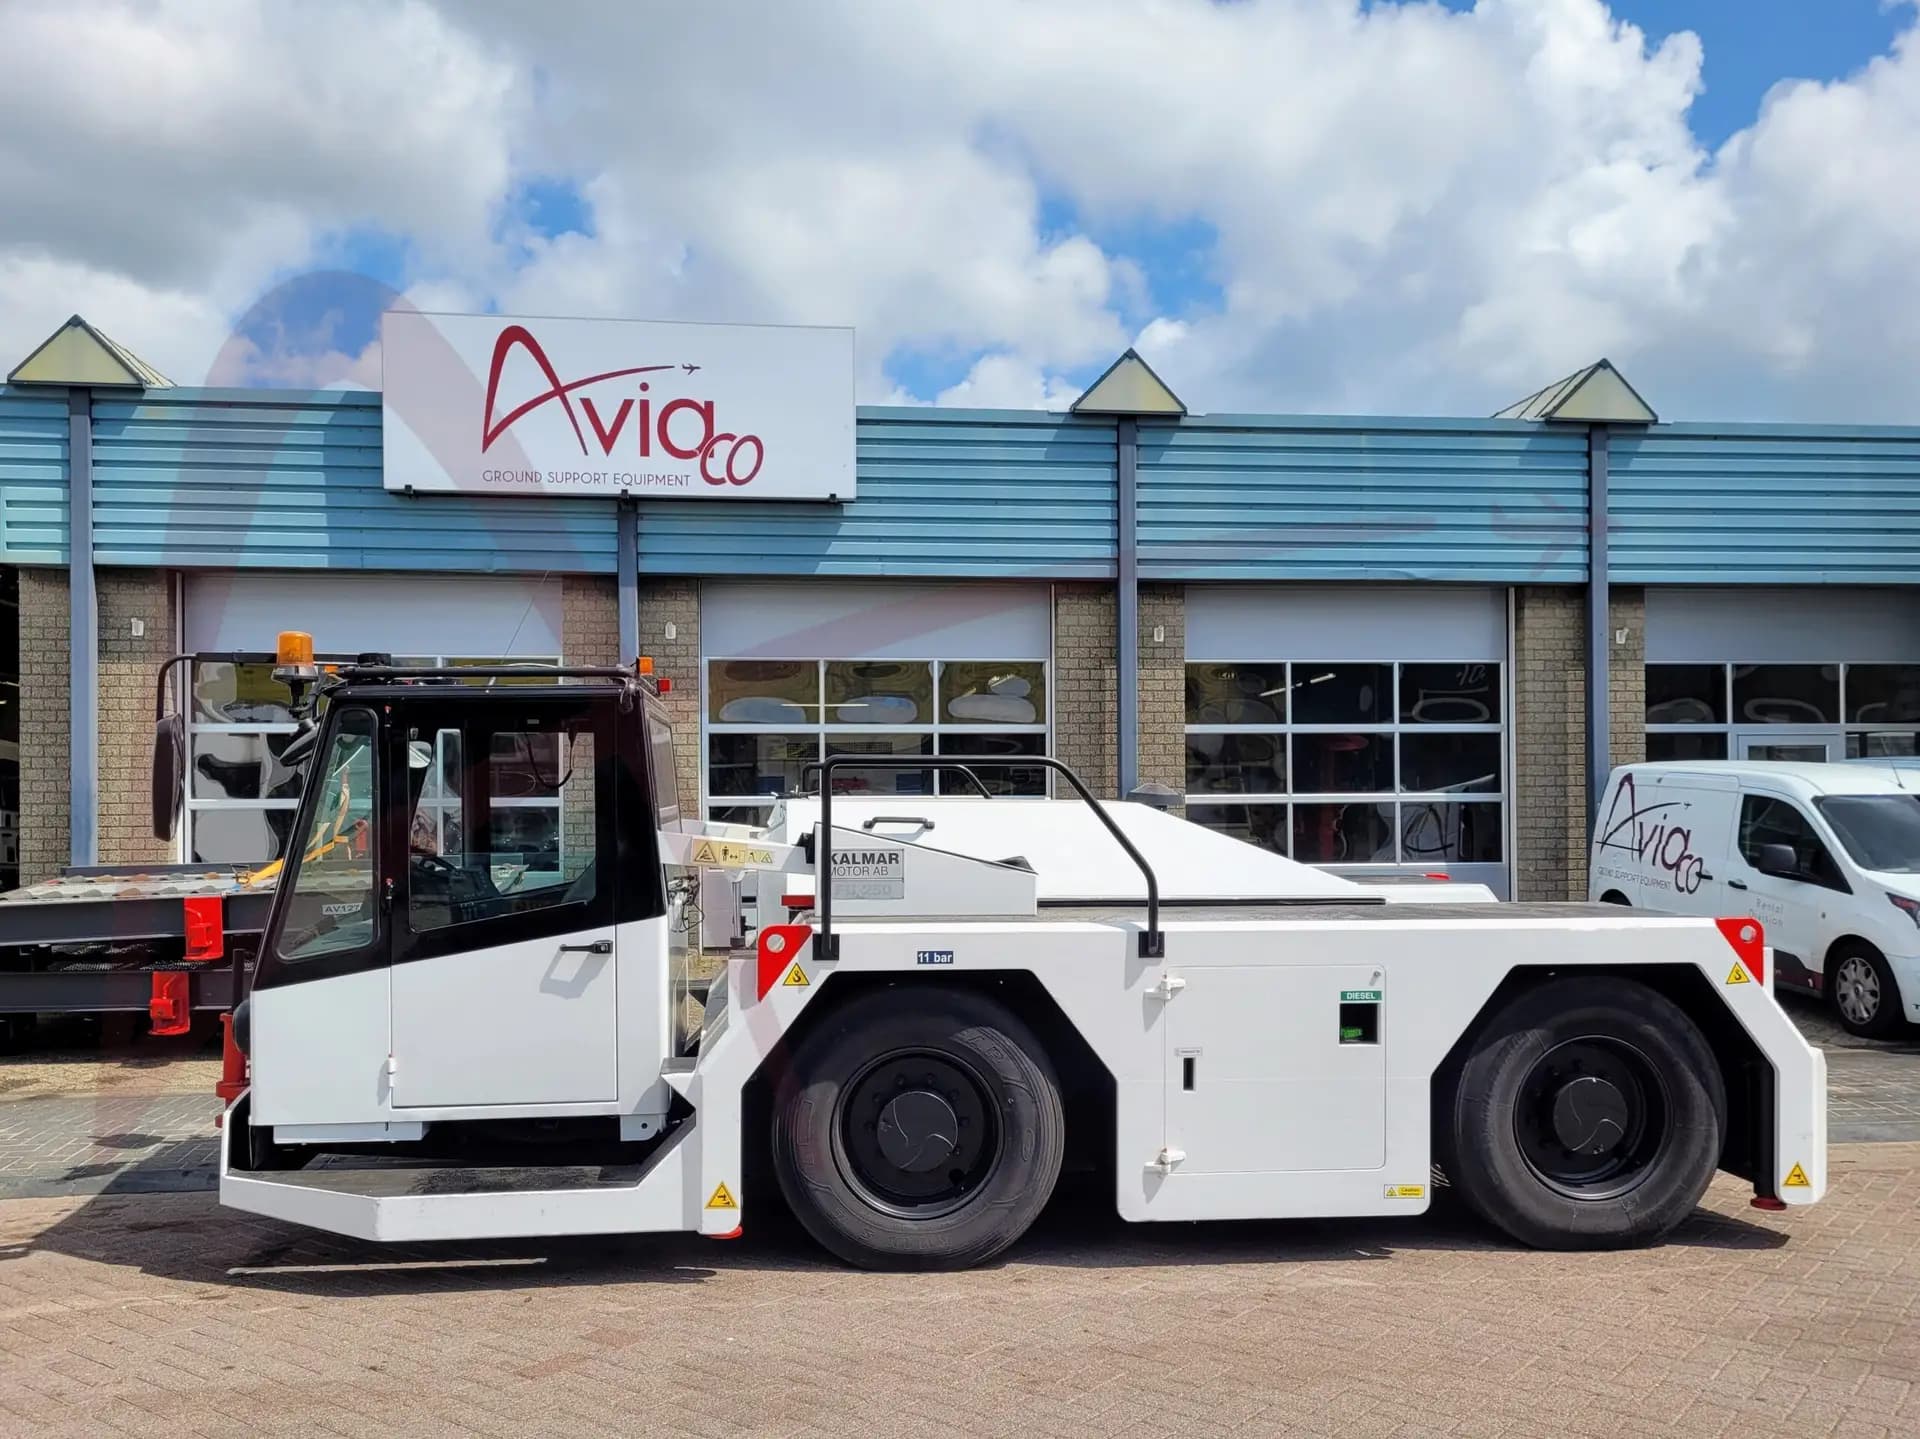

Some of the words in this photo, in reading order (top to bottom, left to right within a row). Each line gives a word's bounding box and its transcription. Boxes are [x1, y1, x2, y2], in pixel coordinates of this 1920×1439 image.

[482, 470, 543, 483] GROUND
[547, 471, 608, 485] SUPPORT
[613, 473, 691, 487] EQUIPMENT
[873, 866, 889, 876] AB
[325, 904, 359, 912] AV127
[919, 952, 929, 962] 11
[934, 952, 952, 962] bar
[1346, 992, 1376, 1000] DIESEL
